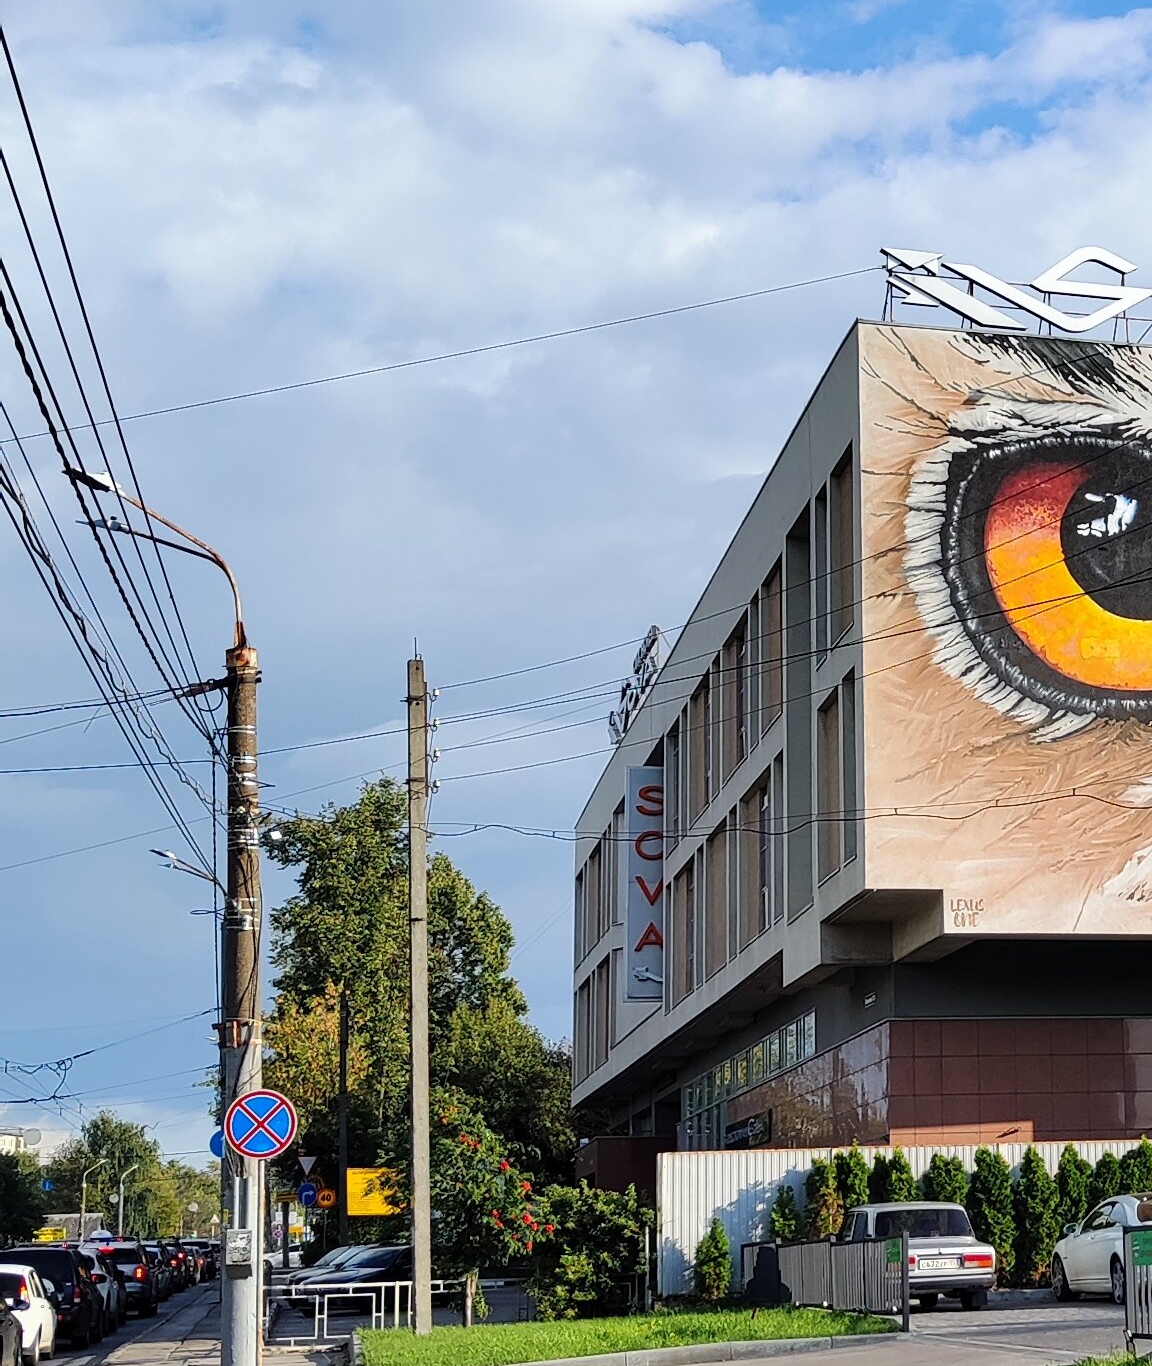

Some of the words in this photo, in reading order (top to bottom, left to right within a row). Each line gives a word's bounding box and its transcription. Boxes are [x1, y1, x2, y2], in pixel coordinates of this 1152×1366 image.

[635, 784, 664, 953] SOVA
[950, 898, 985, 912] LEXUS
[320, 1193, 332, 1202] 40
